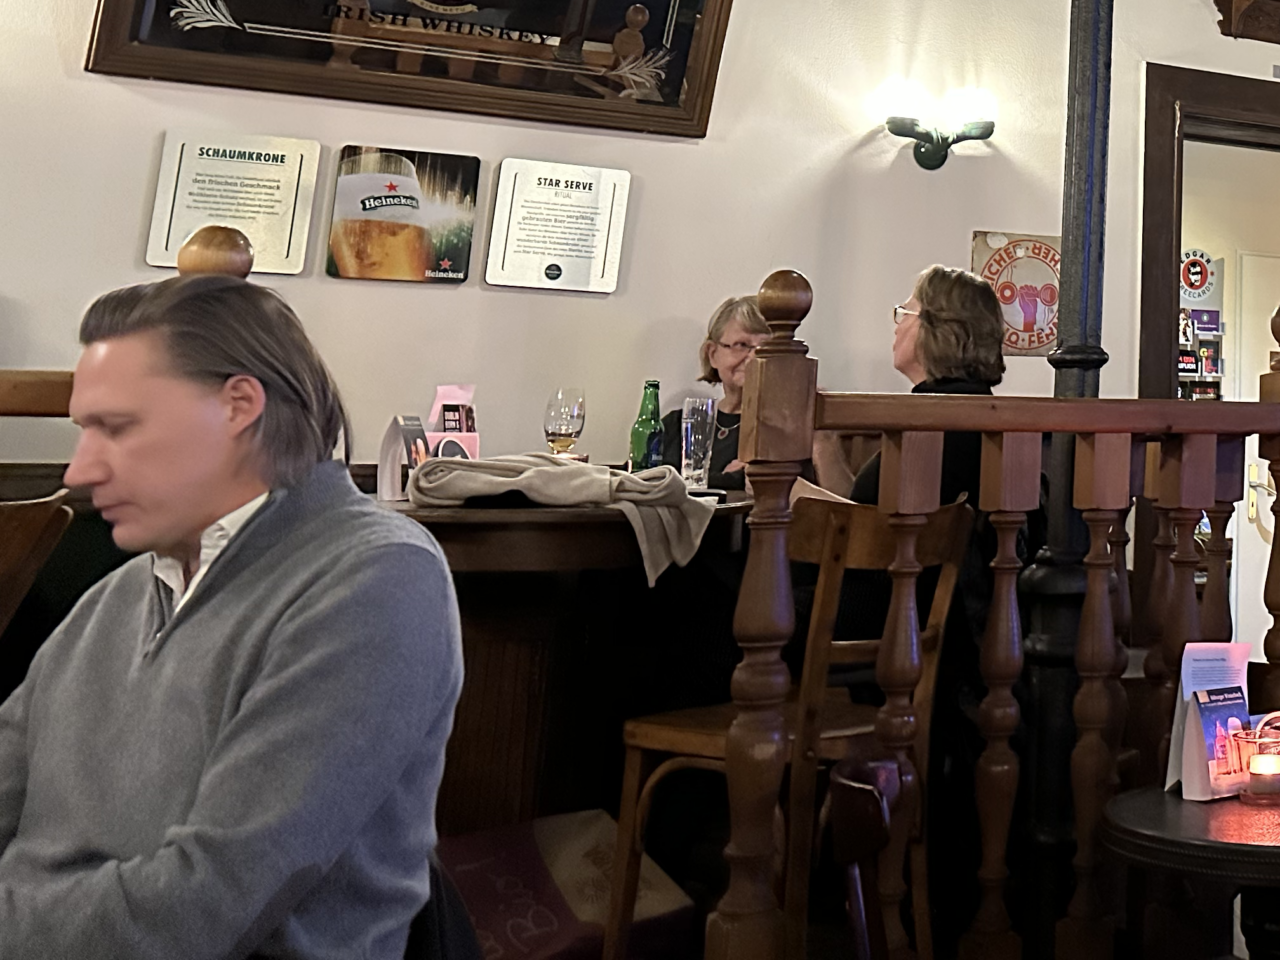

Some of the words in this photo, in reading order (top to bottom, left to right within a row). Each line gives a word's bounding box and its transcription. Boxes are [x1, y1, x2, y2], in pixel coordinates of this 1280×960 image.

[323, 4, 409, 26] IRISH
[421, 16, 558, 45] WHISKEY
[198, 146, 286, 164] SCHAUMKRONE
[240, 181, 280, 190] Geschmack
[537, 177, 561, 188] STAR
[564, 180, 594, 191] SERVE
[554, 191, 572, 199] RITUAL
[365, 197, 418, 209] Heineken
[425, 270, 464, 279] Heineken
